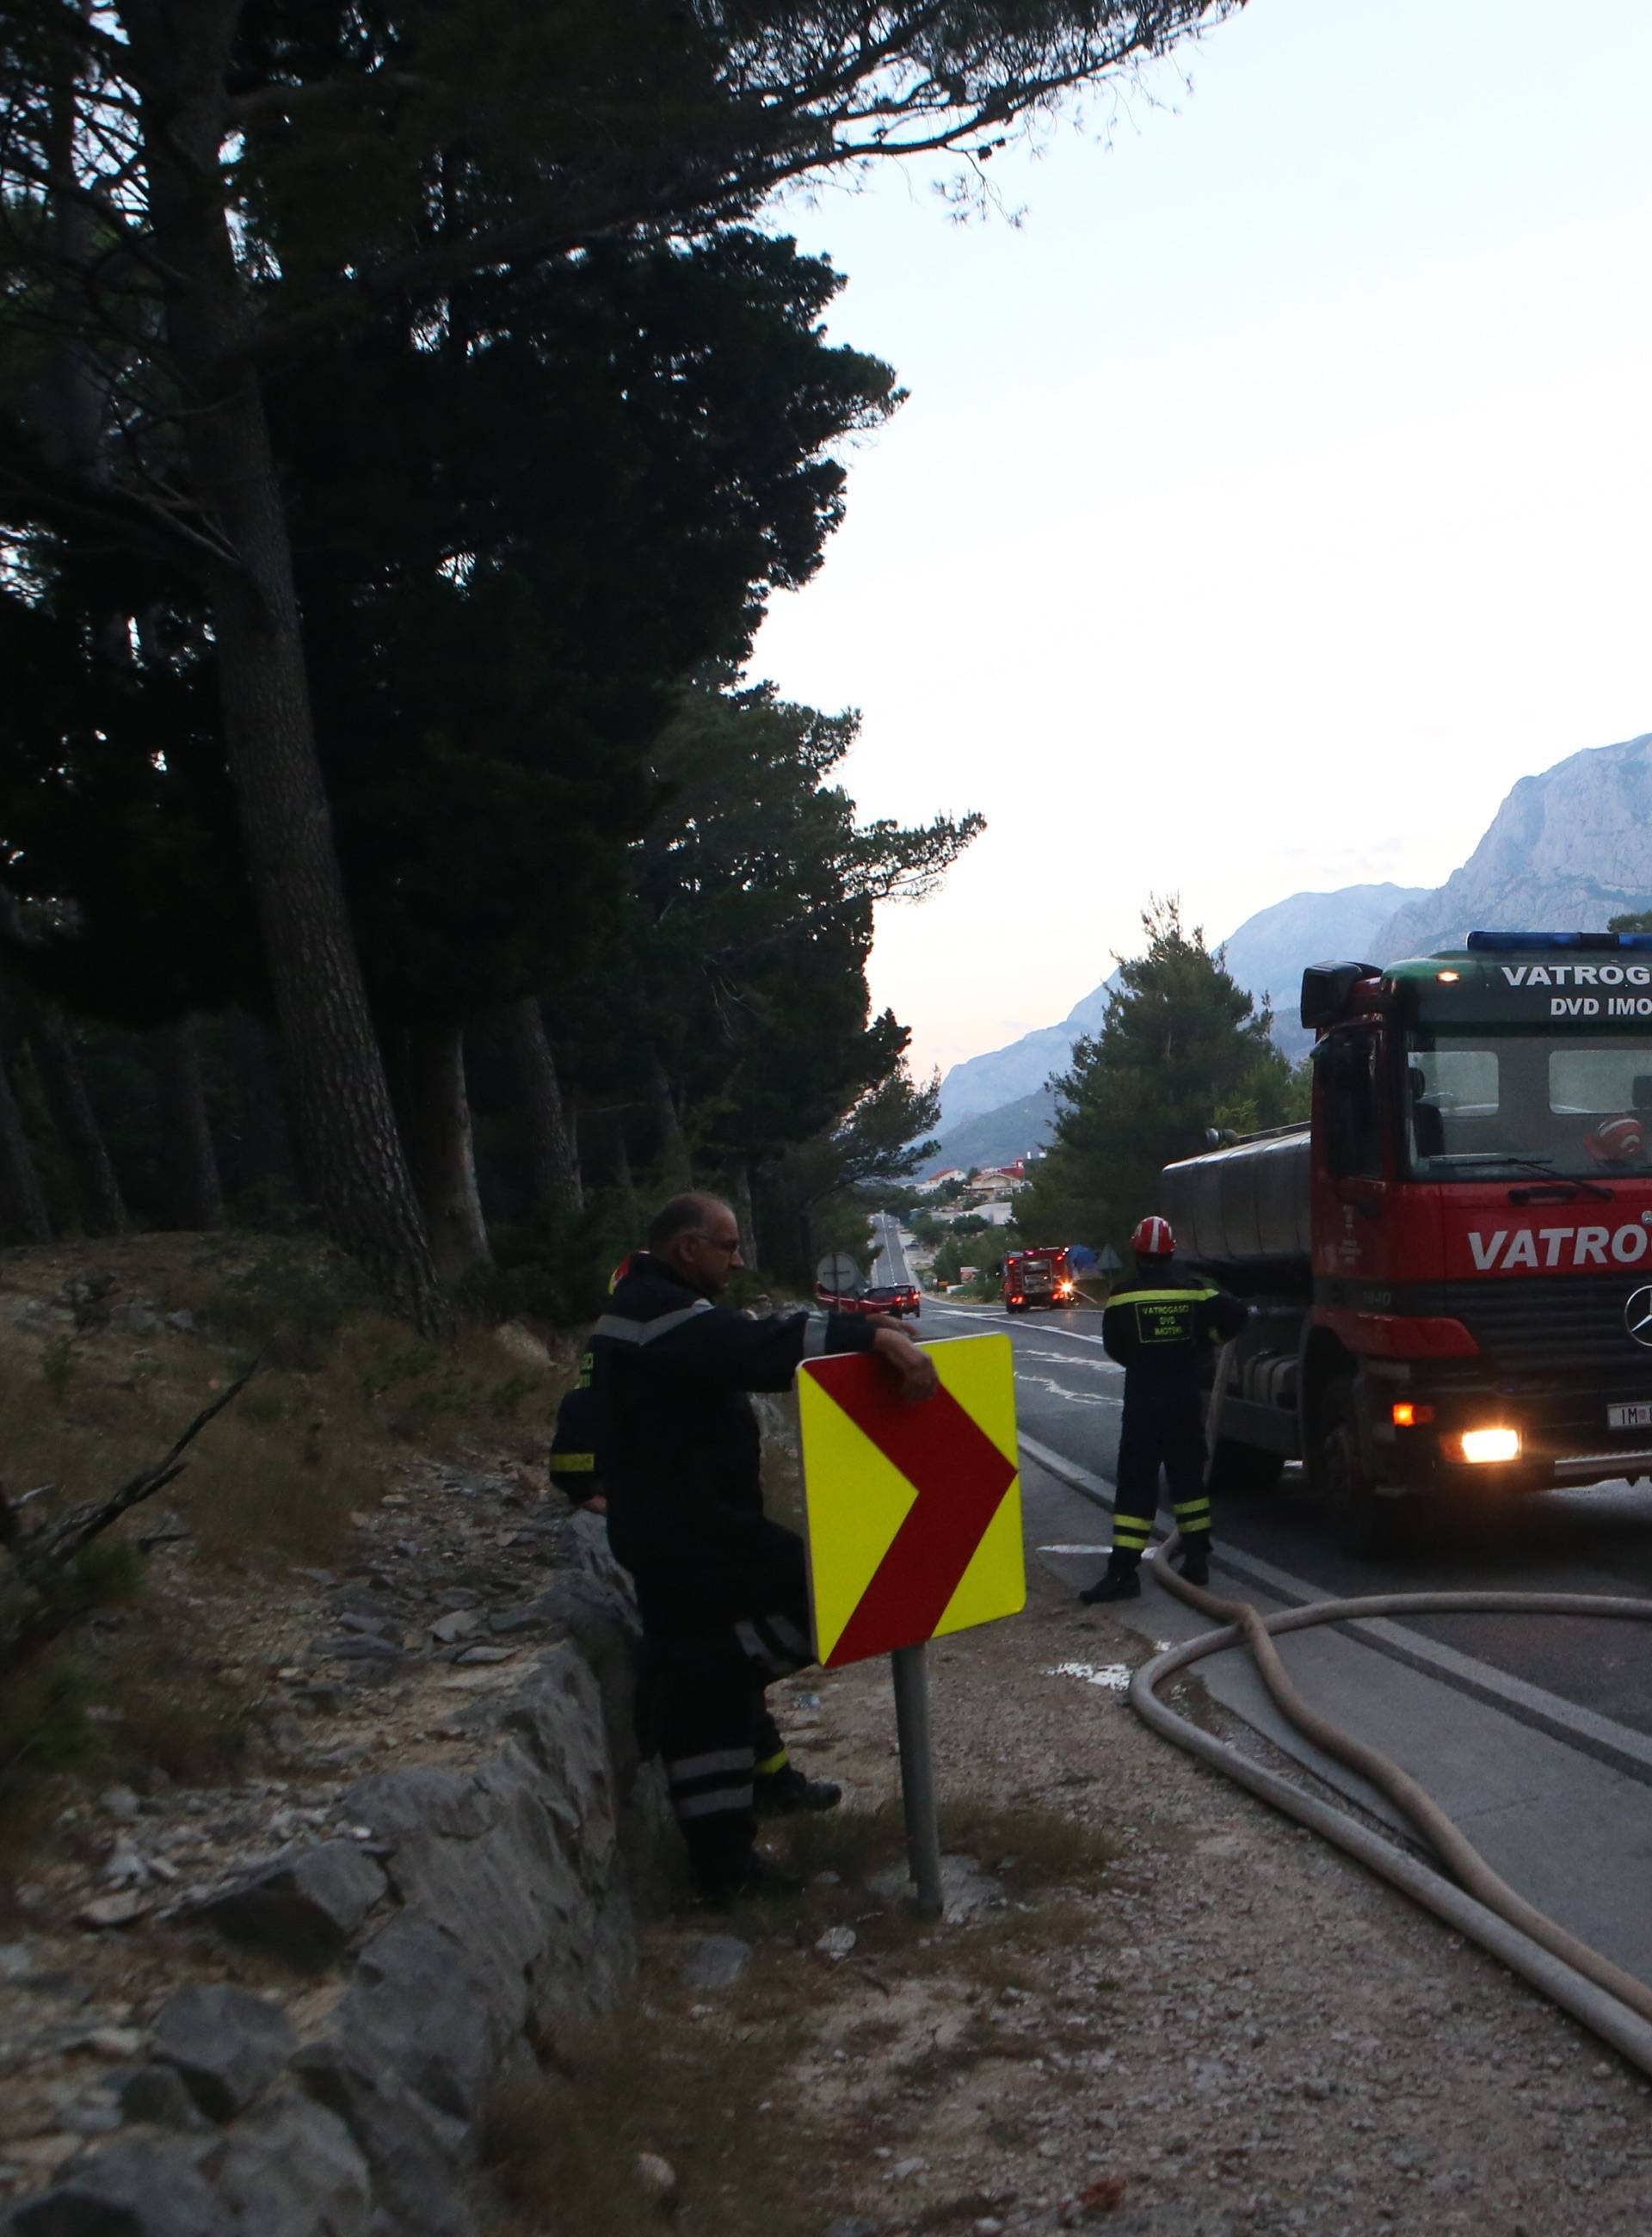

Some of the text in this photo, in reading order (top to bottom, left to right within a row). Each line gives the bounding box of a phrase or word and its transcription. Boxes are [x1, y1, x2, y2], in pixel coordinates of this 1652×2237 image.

[1501, 966, 1651, 986] VATROG
[1550, 998, 1652, 1015] DVD IMO
[1468, 1224, 1652, 1270] VATRO
